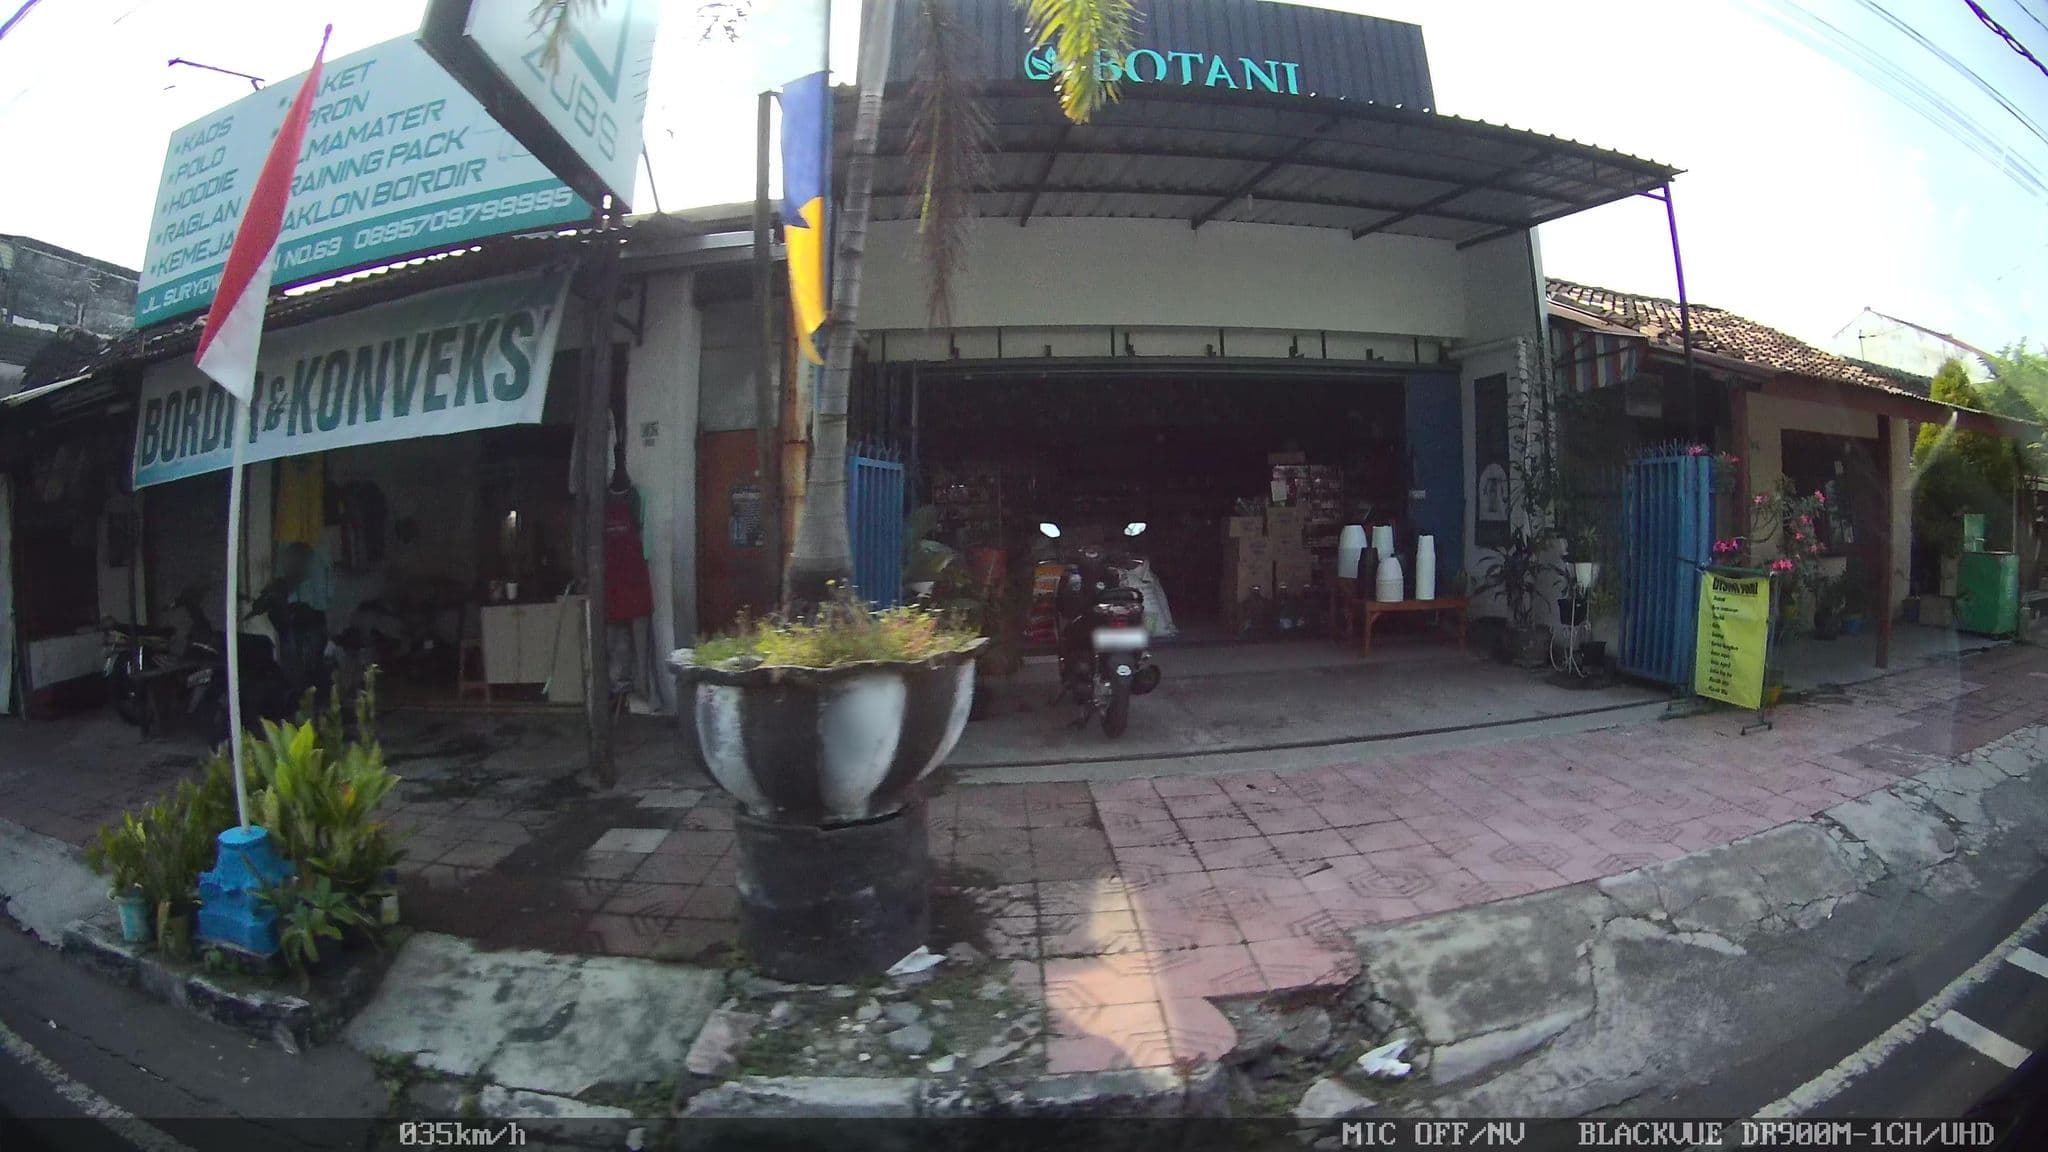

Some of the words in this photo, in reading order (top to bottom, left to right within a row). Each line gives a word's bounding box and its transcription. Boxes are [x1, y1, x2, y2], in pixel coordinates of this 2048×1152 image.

[181, 116, 235, 155] KAOS
[174, 146, 226, 184] POLO
[291, 150, 385, 197] RAINING
[387, 126, 470, 169] PACK
[168, 168, 239, 216] HOODIE
[281, 186, 370, 233] AKLON
[373, 157, 487, 208] BORDIR
[162, 197, 242, 246] RAGLAN
